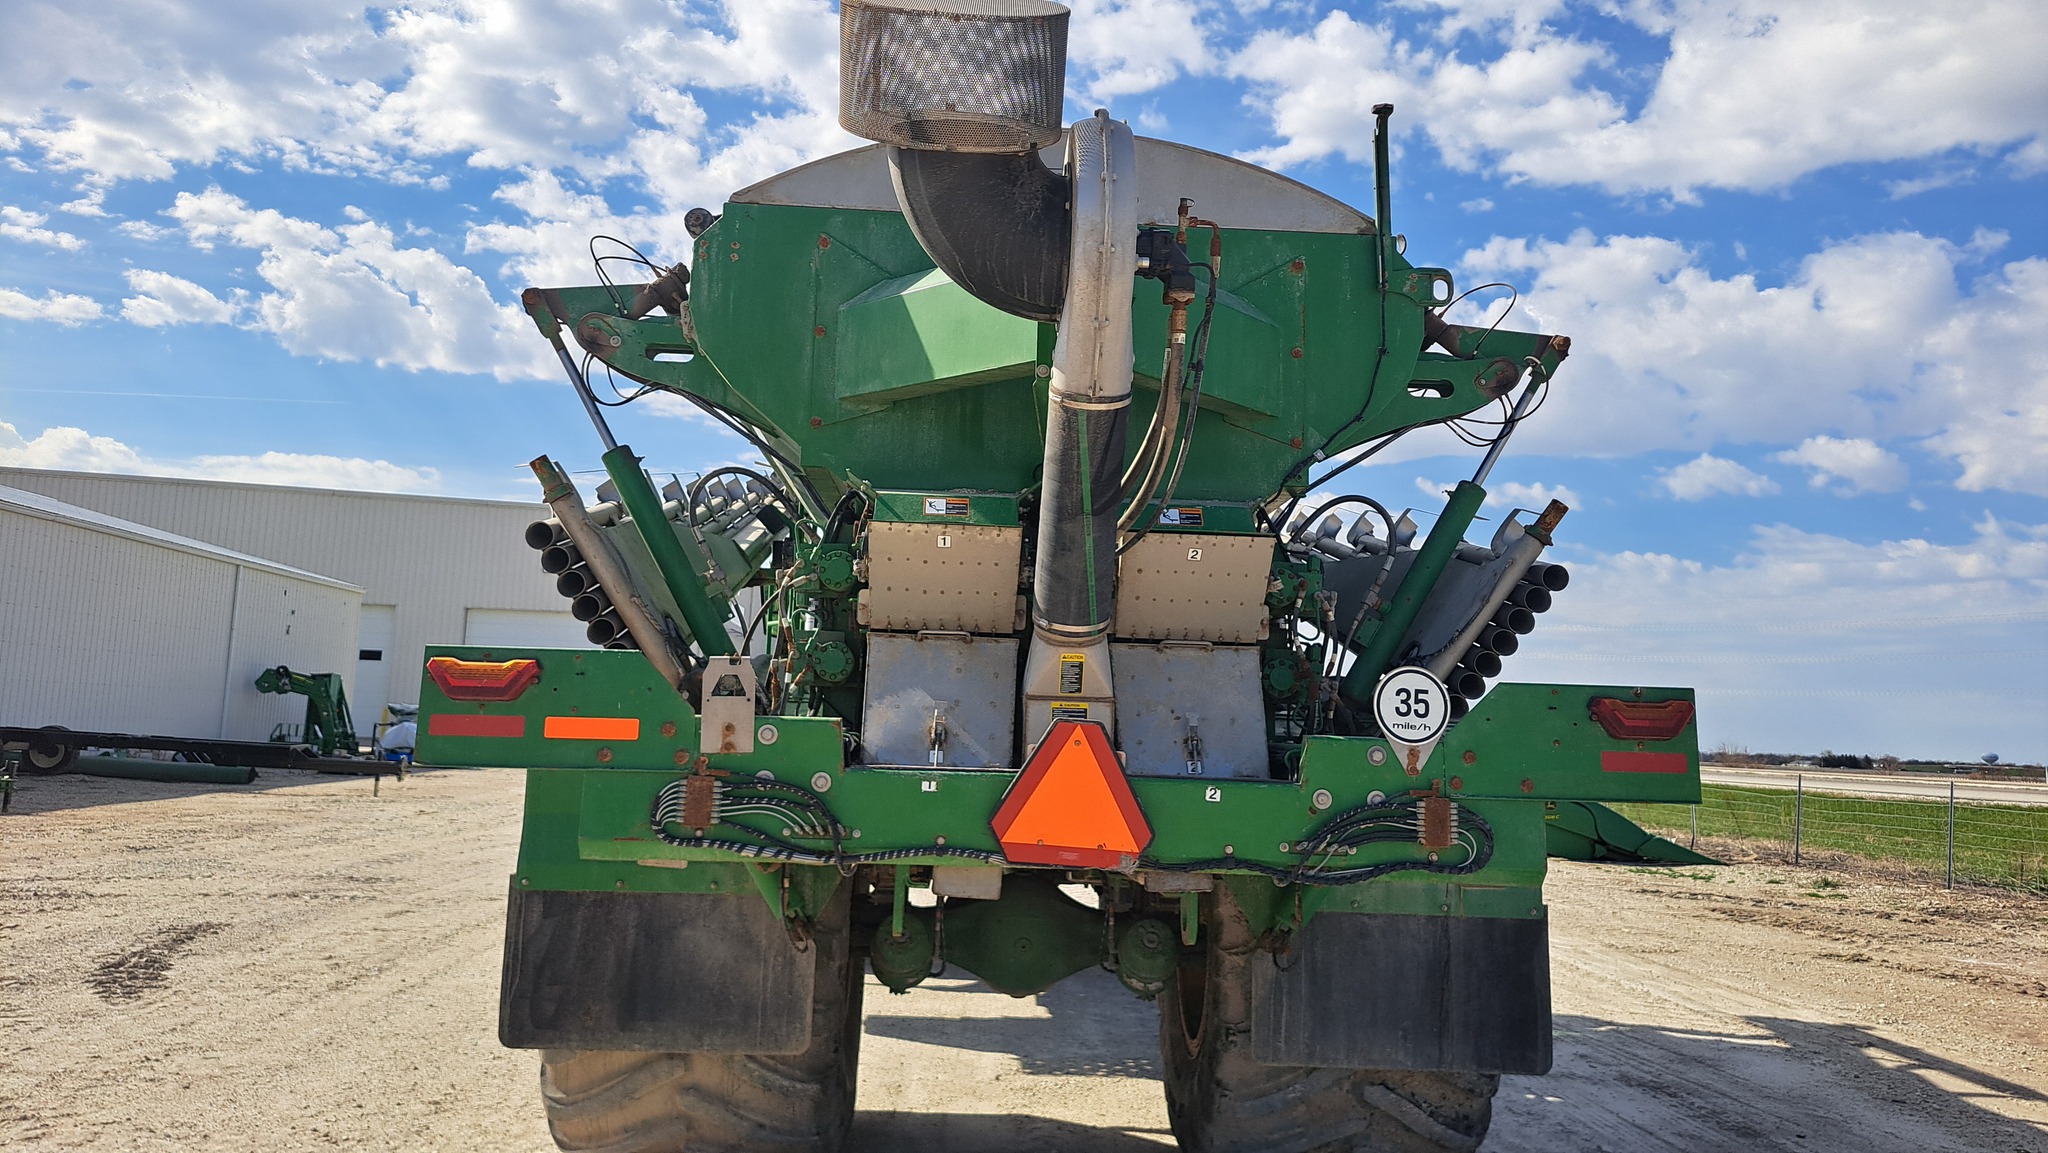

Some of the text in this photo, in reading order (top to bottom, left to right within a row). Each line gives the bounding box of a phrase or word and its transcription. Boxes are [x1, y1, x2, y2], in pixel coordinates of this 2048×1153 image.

[1190, 549, 1199, 559] 2
[1395, 687, 1430, 719] 35
[1392, 722, 1431, 732] mile/h
[1208, 787, 1217, 800] 2
